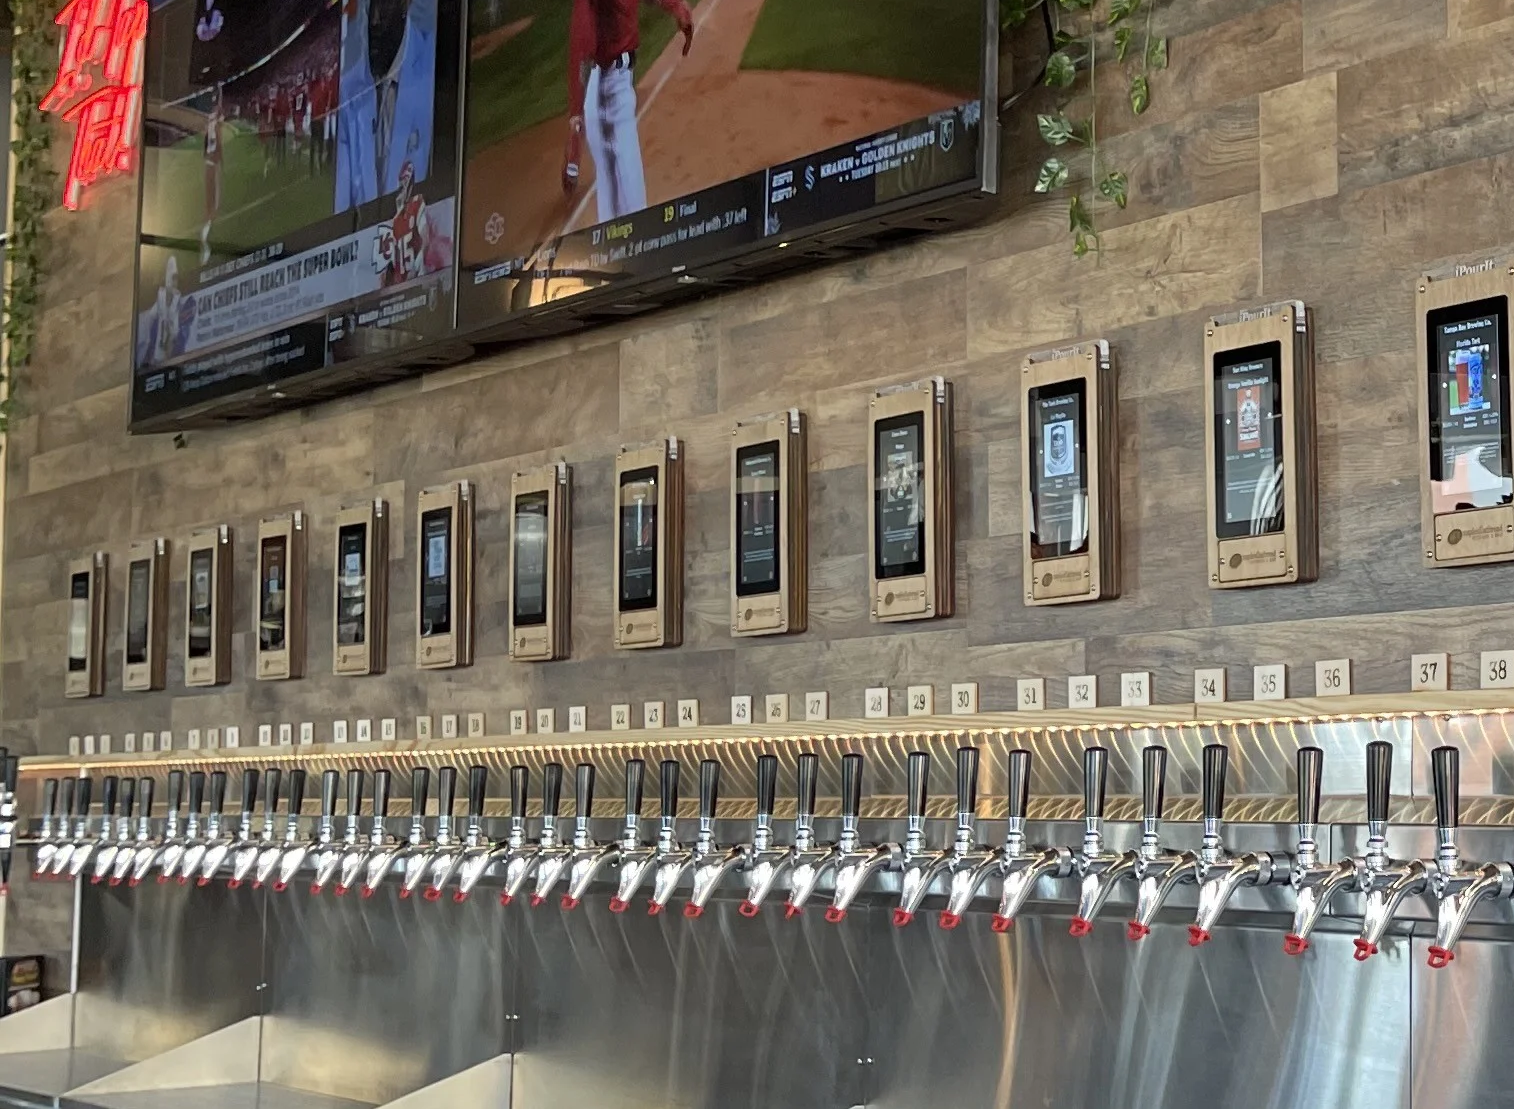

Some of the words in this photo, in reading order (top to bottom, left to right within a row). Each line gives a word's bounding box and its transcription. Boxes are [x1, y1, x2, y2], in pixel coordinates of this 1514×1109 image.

[820, 154, 854, 178] KRAKEN
[861, 142, 895, 165] GOLDEN
[896, 130, 935, 154] KNIGHTS
[772, 169, 793, 188] ESPN
[606, 222, 633, 242] Vikings
[663, 205, 675, 223] 19
[679, 200, 697, 219] Final
[1323, 667, 1341, 689] 36
[1420, 661, 1438, 684] 37
[1489, 659, 1507, 682] 38
[1075, 683, 1089, 702] 32
[1127, 680, 1143, 698] 33
[1201, 678, 1216, 697] 34
[1260, 673, 1277, 694] 35
[870, 695, 883, 712] 28
[913, 693, 926, 711] 29
[957, 690, 970, 708] 30
[1024, 687, 1037, 705] 31
[648, 708, 659, 723] 23
[682, 706, 693, 722] 24
[735, 702, 747, 719] 25
[770, 702, 782, 718] 26
[809, 699, 821, 716] 27
[513, 715, 522, 731] 19
[540, 714, 549, 728] 20
[573, 712, 582, 727] 21
[615, 710, 625, 725] 22
